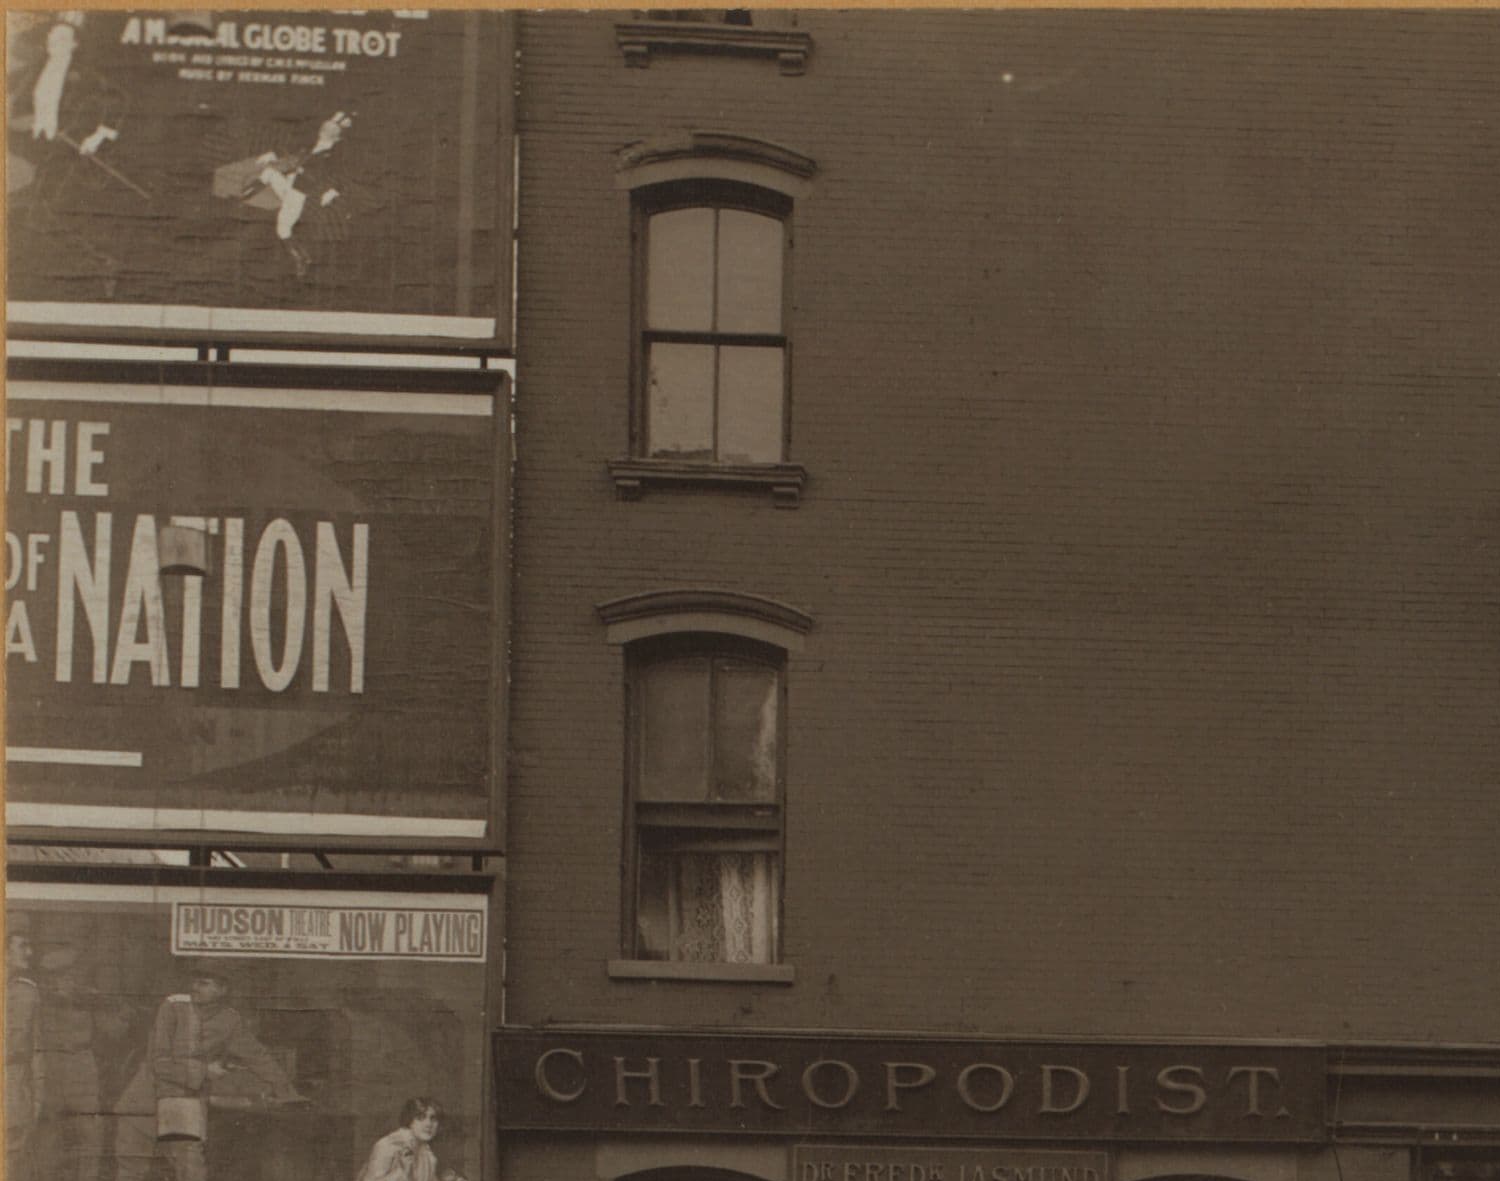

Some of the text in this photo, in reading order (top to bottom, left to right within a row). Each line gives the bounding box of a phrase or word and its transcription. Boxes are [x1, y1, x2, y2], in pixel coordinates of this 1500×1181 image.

[243, 23, 327, 53] GLOBE
[332, 28, 402, 58] TROT
[55, 510, 370, 694] NATION
[182, 906, 285, 937] HUDSON
[339, 910, 386, 953] NOW
[394, 913, 482, 954] PLAYING
